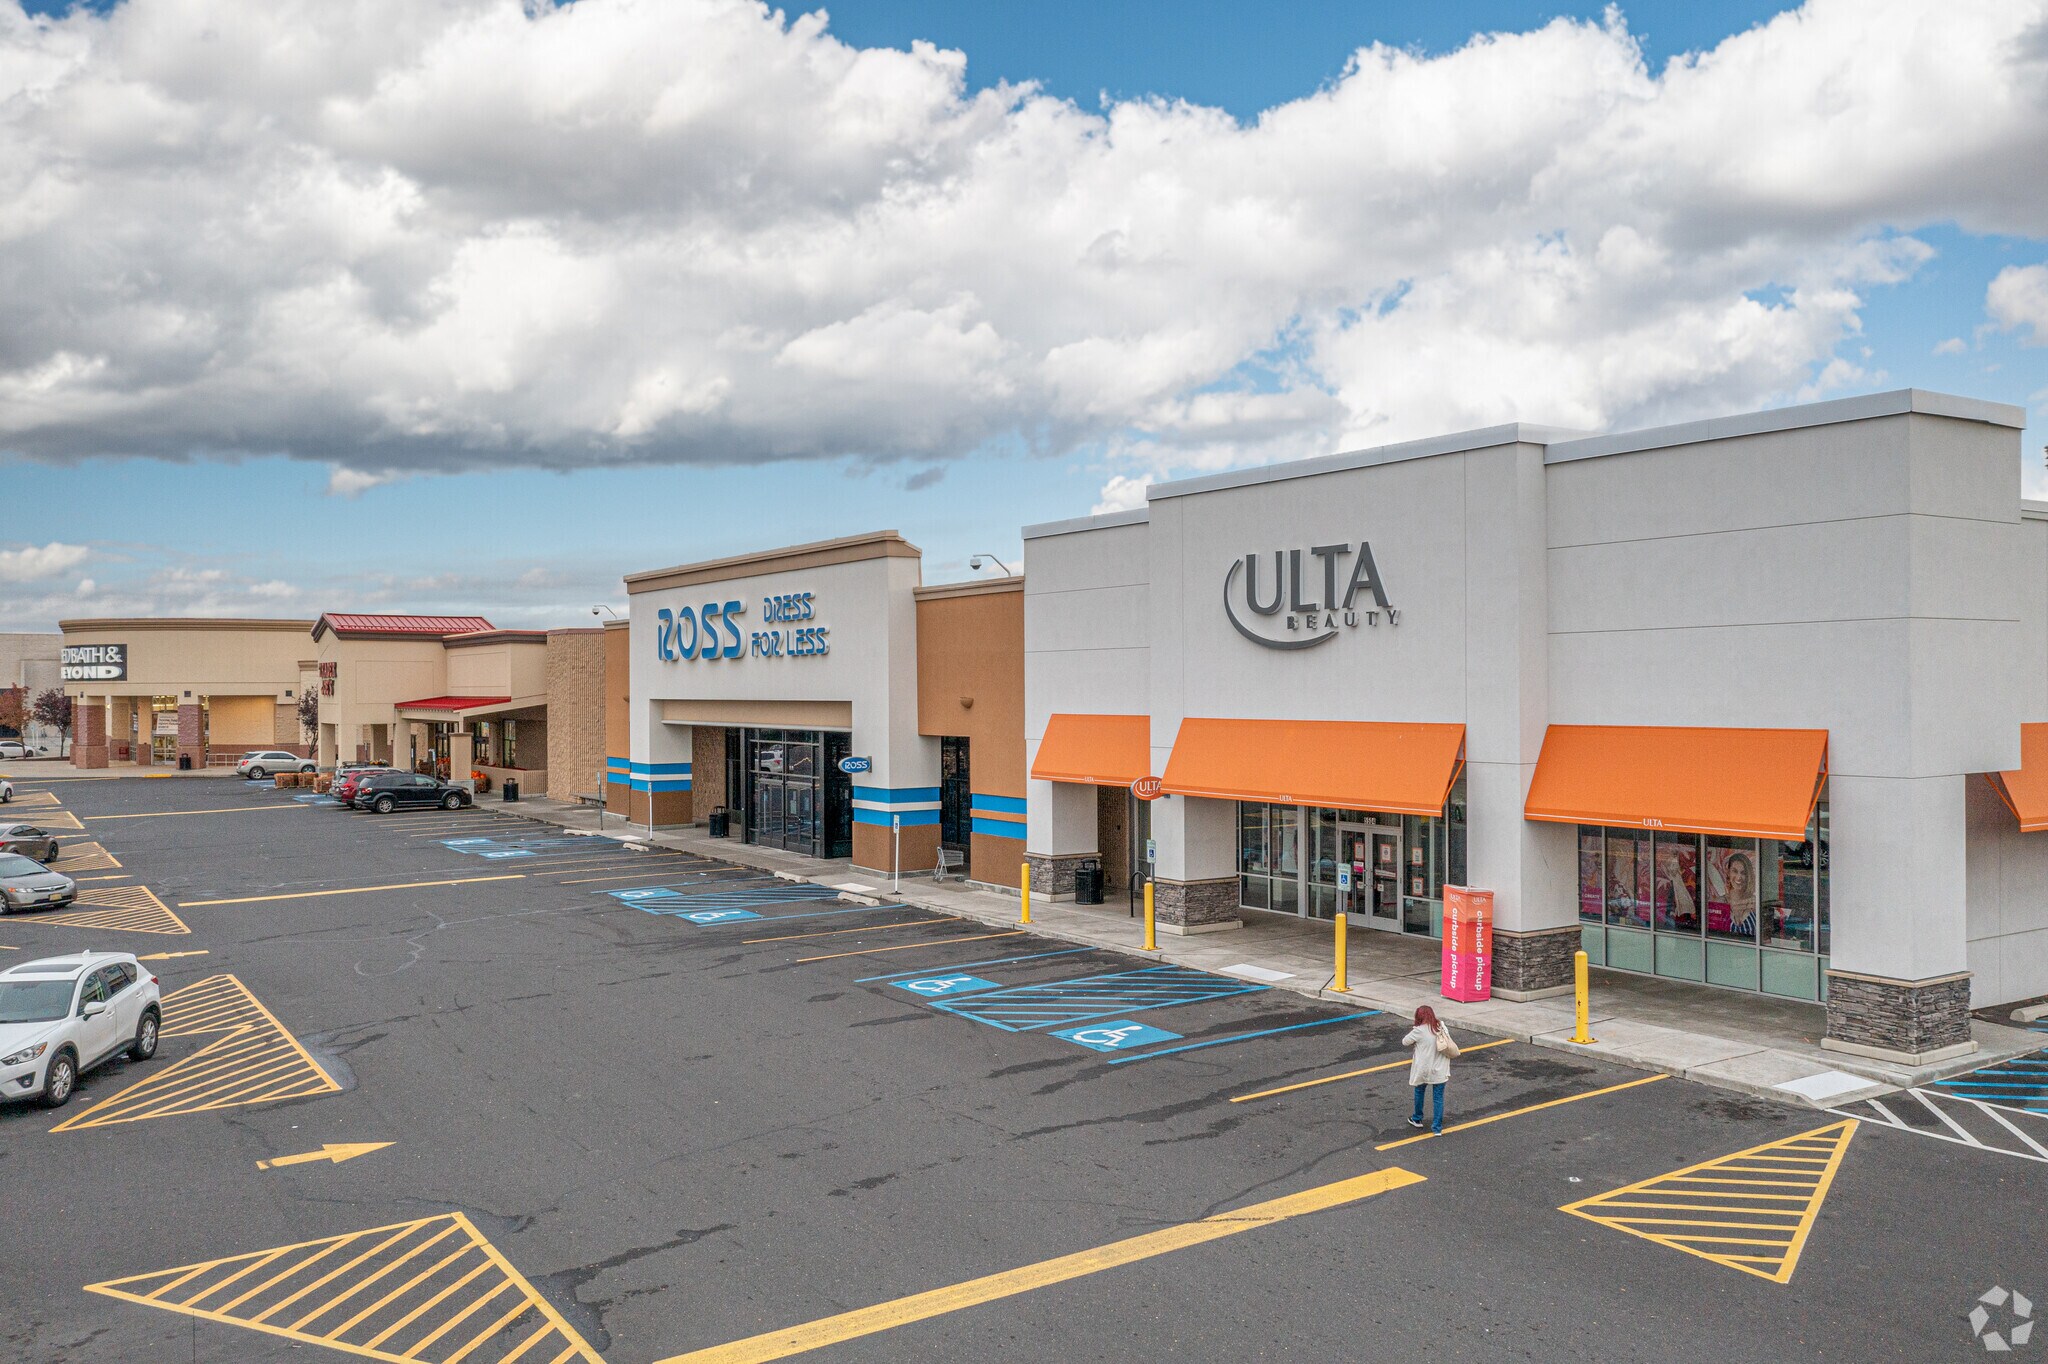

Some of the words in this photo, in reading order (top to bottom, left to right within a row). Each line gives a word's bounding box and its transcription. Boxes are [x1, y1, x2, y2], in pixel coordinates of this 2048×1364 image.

[1246, 541, 1393, 615] ULTA
[763, 592, 815, 623] DRESS
[1287, 610, 1401, 630] BEAUTY
[658, 600, 747, 661] ROSS
[752, 630, 784, 657] FOR
[787, 627, 829, 656] LESS
[71, 647, 105, 663] BATH
[61, 666, 123, 679] EYOND
[844, 761, 868, 770] ROSS
[1140, 781, 1162, 792] ULTA
[1643, 818, 1663, 828] ULTA
[1451, 907, 1459, 952] curbside
[1475, 910, 1484, 954] curbside
[1450, 953, 1458, 989] pickup
[1474, 956, 1485, 991] pickup
